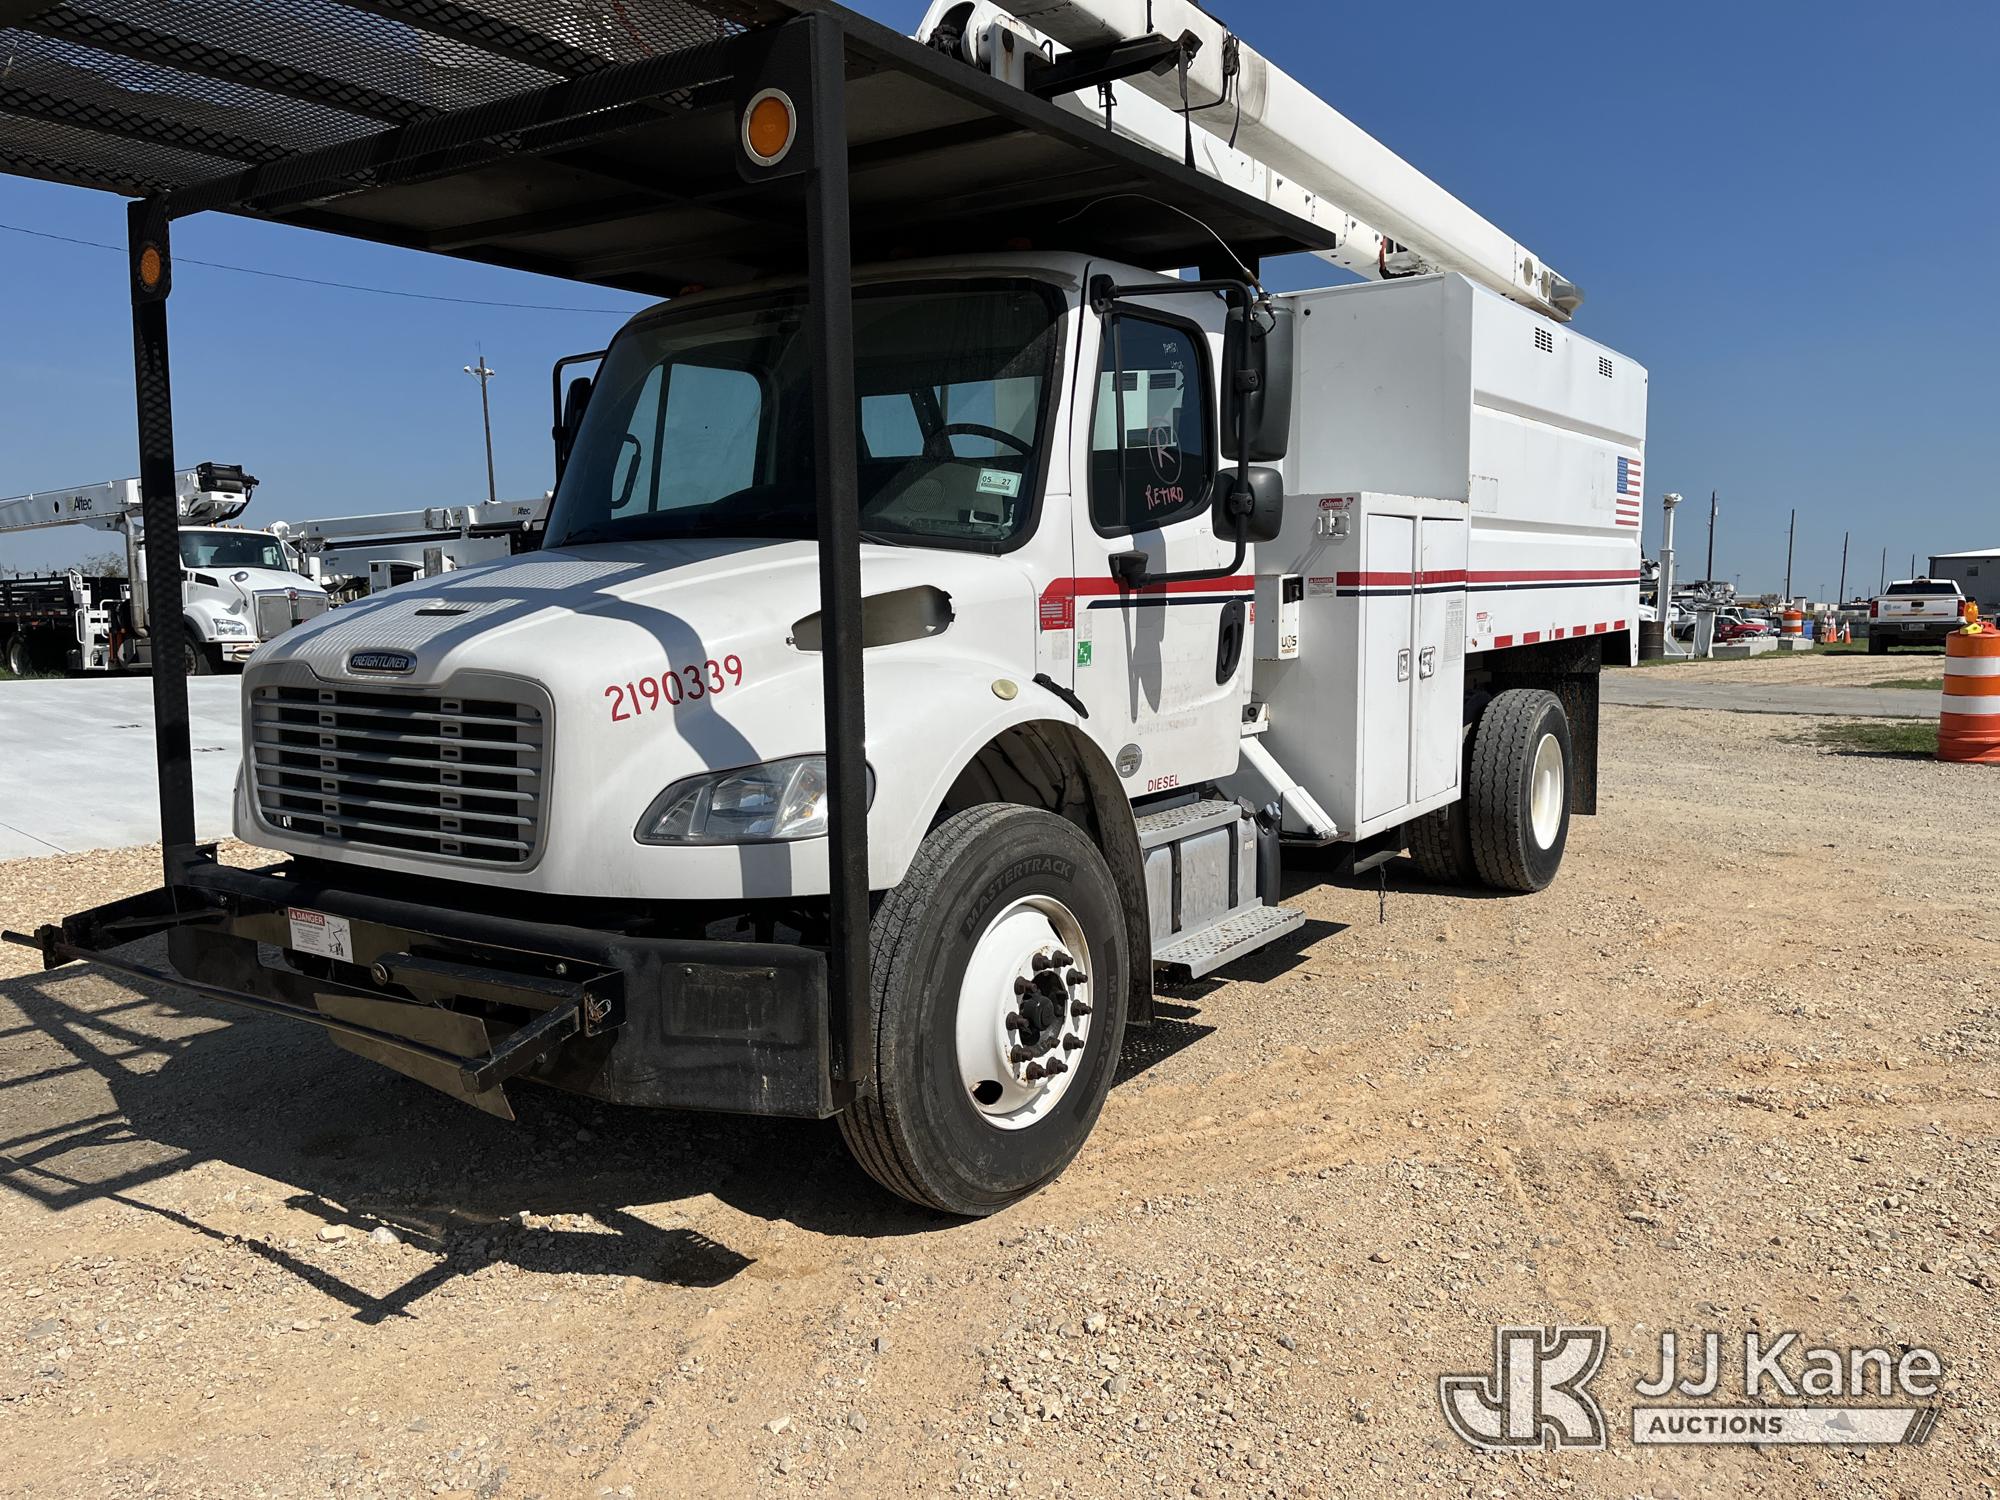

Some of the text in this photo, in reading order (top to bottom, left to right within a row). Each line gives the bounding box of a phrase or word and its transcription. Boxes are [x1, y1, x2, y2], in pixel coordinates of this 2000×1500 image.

[1001, 478, 1011, 486] 27
[73, 496, 92, 511] Altec
[351, 655, 408, 668] FREIGHTLINER
[604, 654, 743, 722] 2190339
[1147, 774, 1180, 792] DIESEL
[966, 858, 1072, 931] MASTERTRACK
[296, 911, 325, 925] DANGER
